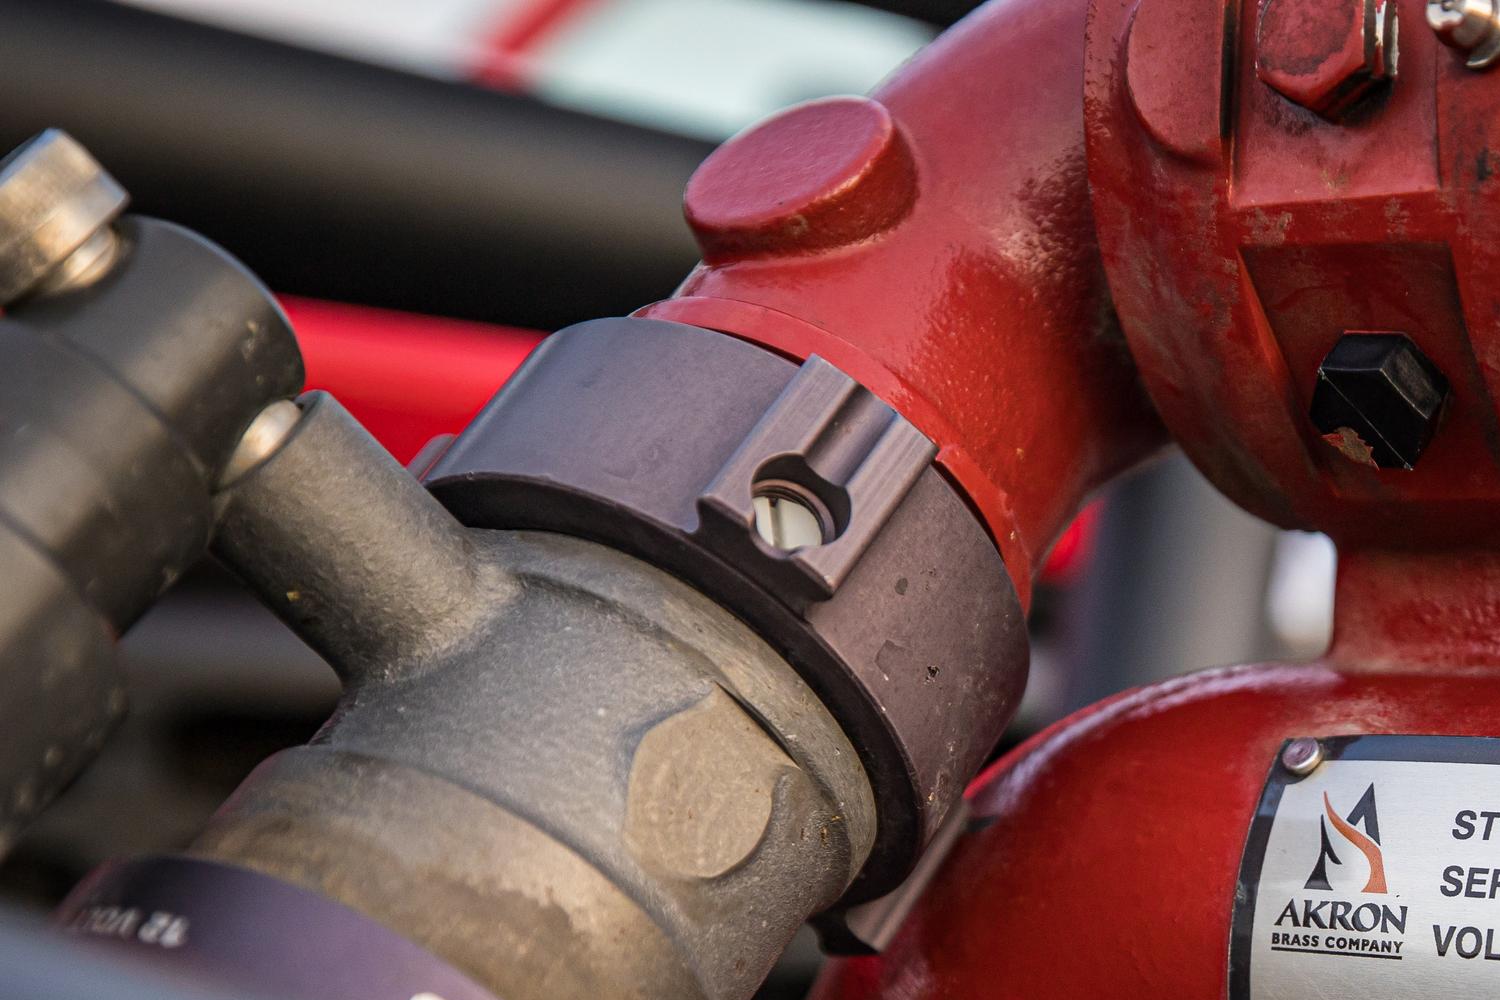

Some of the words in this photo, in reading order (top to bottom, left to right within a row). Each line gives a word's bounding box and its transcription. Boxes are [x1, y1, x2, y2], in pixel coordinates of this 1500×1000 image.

[1274, 898, 1408, 935] AKRON
[1272, 932, 1319, 947] BRASS
[1325, 936, 1404, 953] COMPANY
